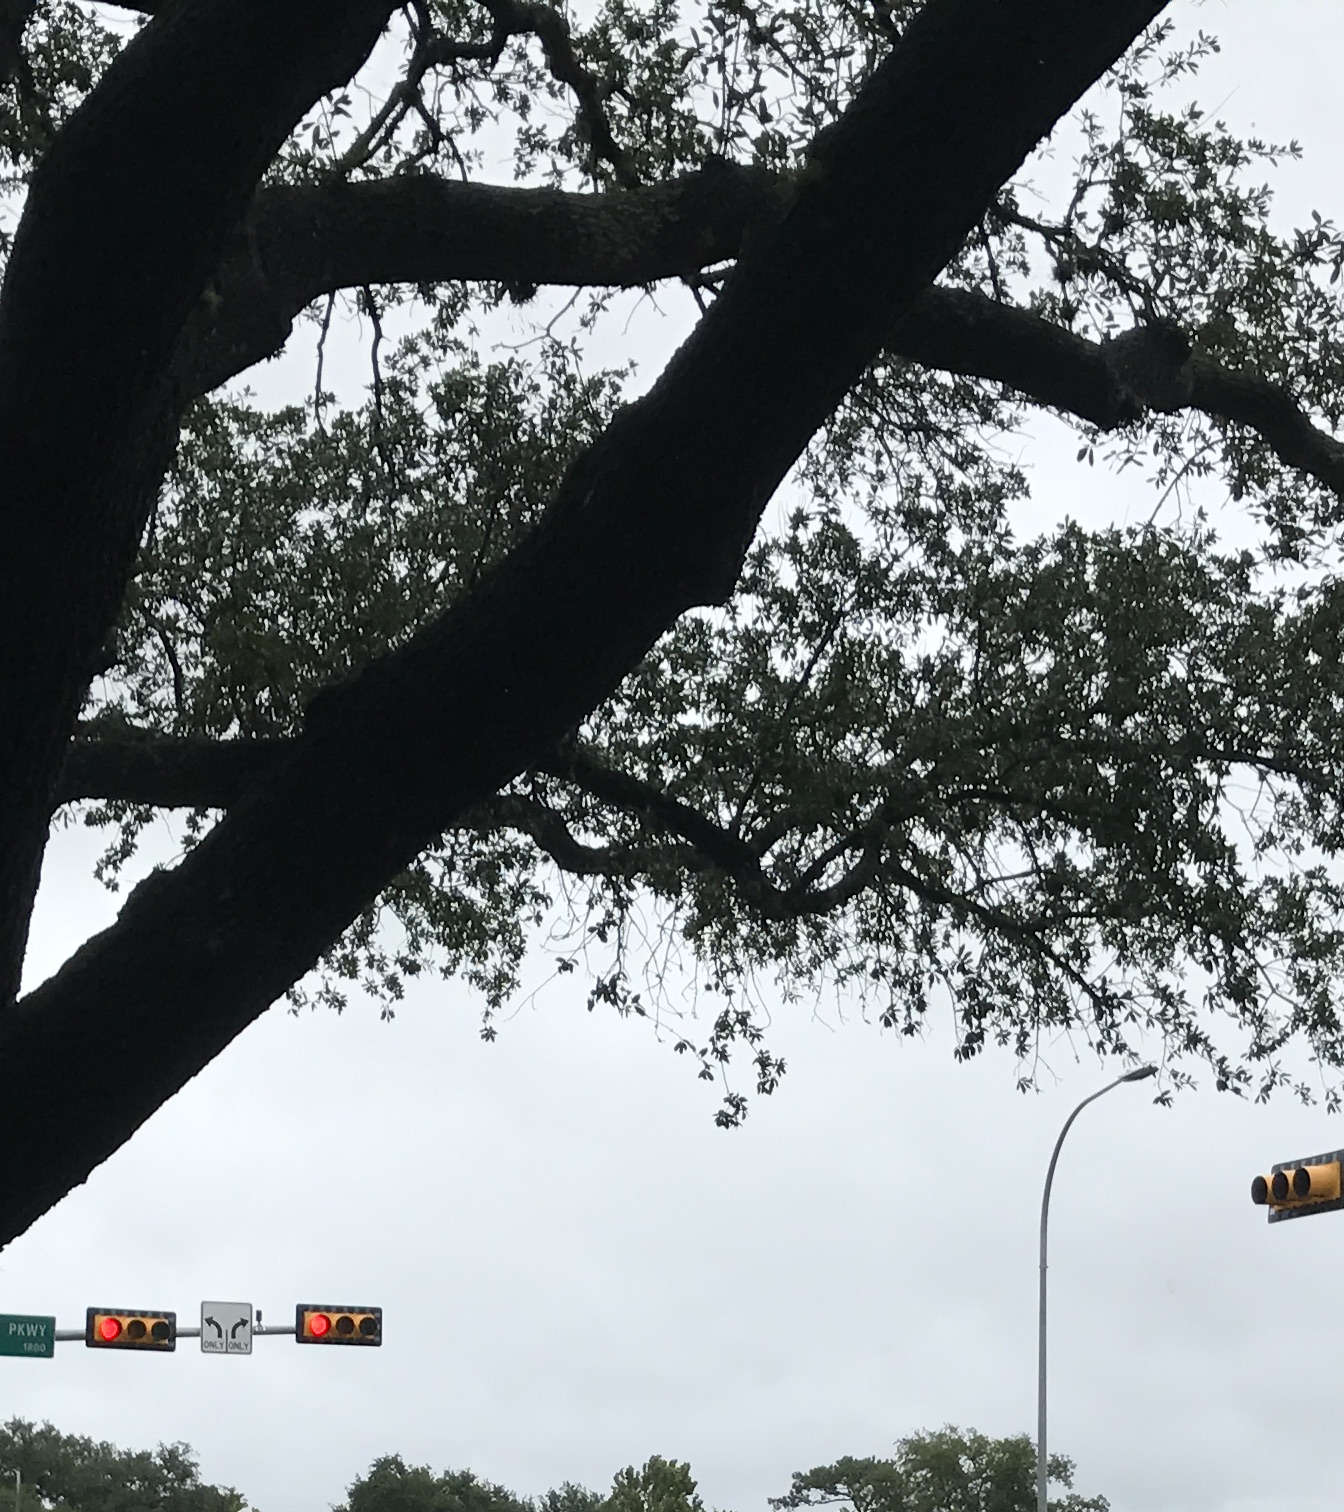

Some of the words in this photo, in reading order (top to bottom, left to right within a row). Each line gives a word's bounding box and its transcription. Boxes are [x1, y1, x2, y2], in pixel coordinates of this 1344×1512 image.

[8, 1322, 47, 1337] PKWY
[204, 1340, 224, 1350] ONLY
[228, 1341, 249, 1351] ONLY
